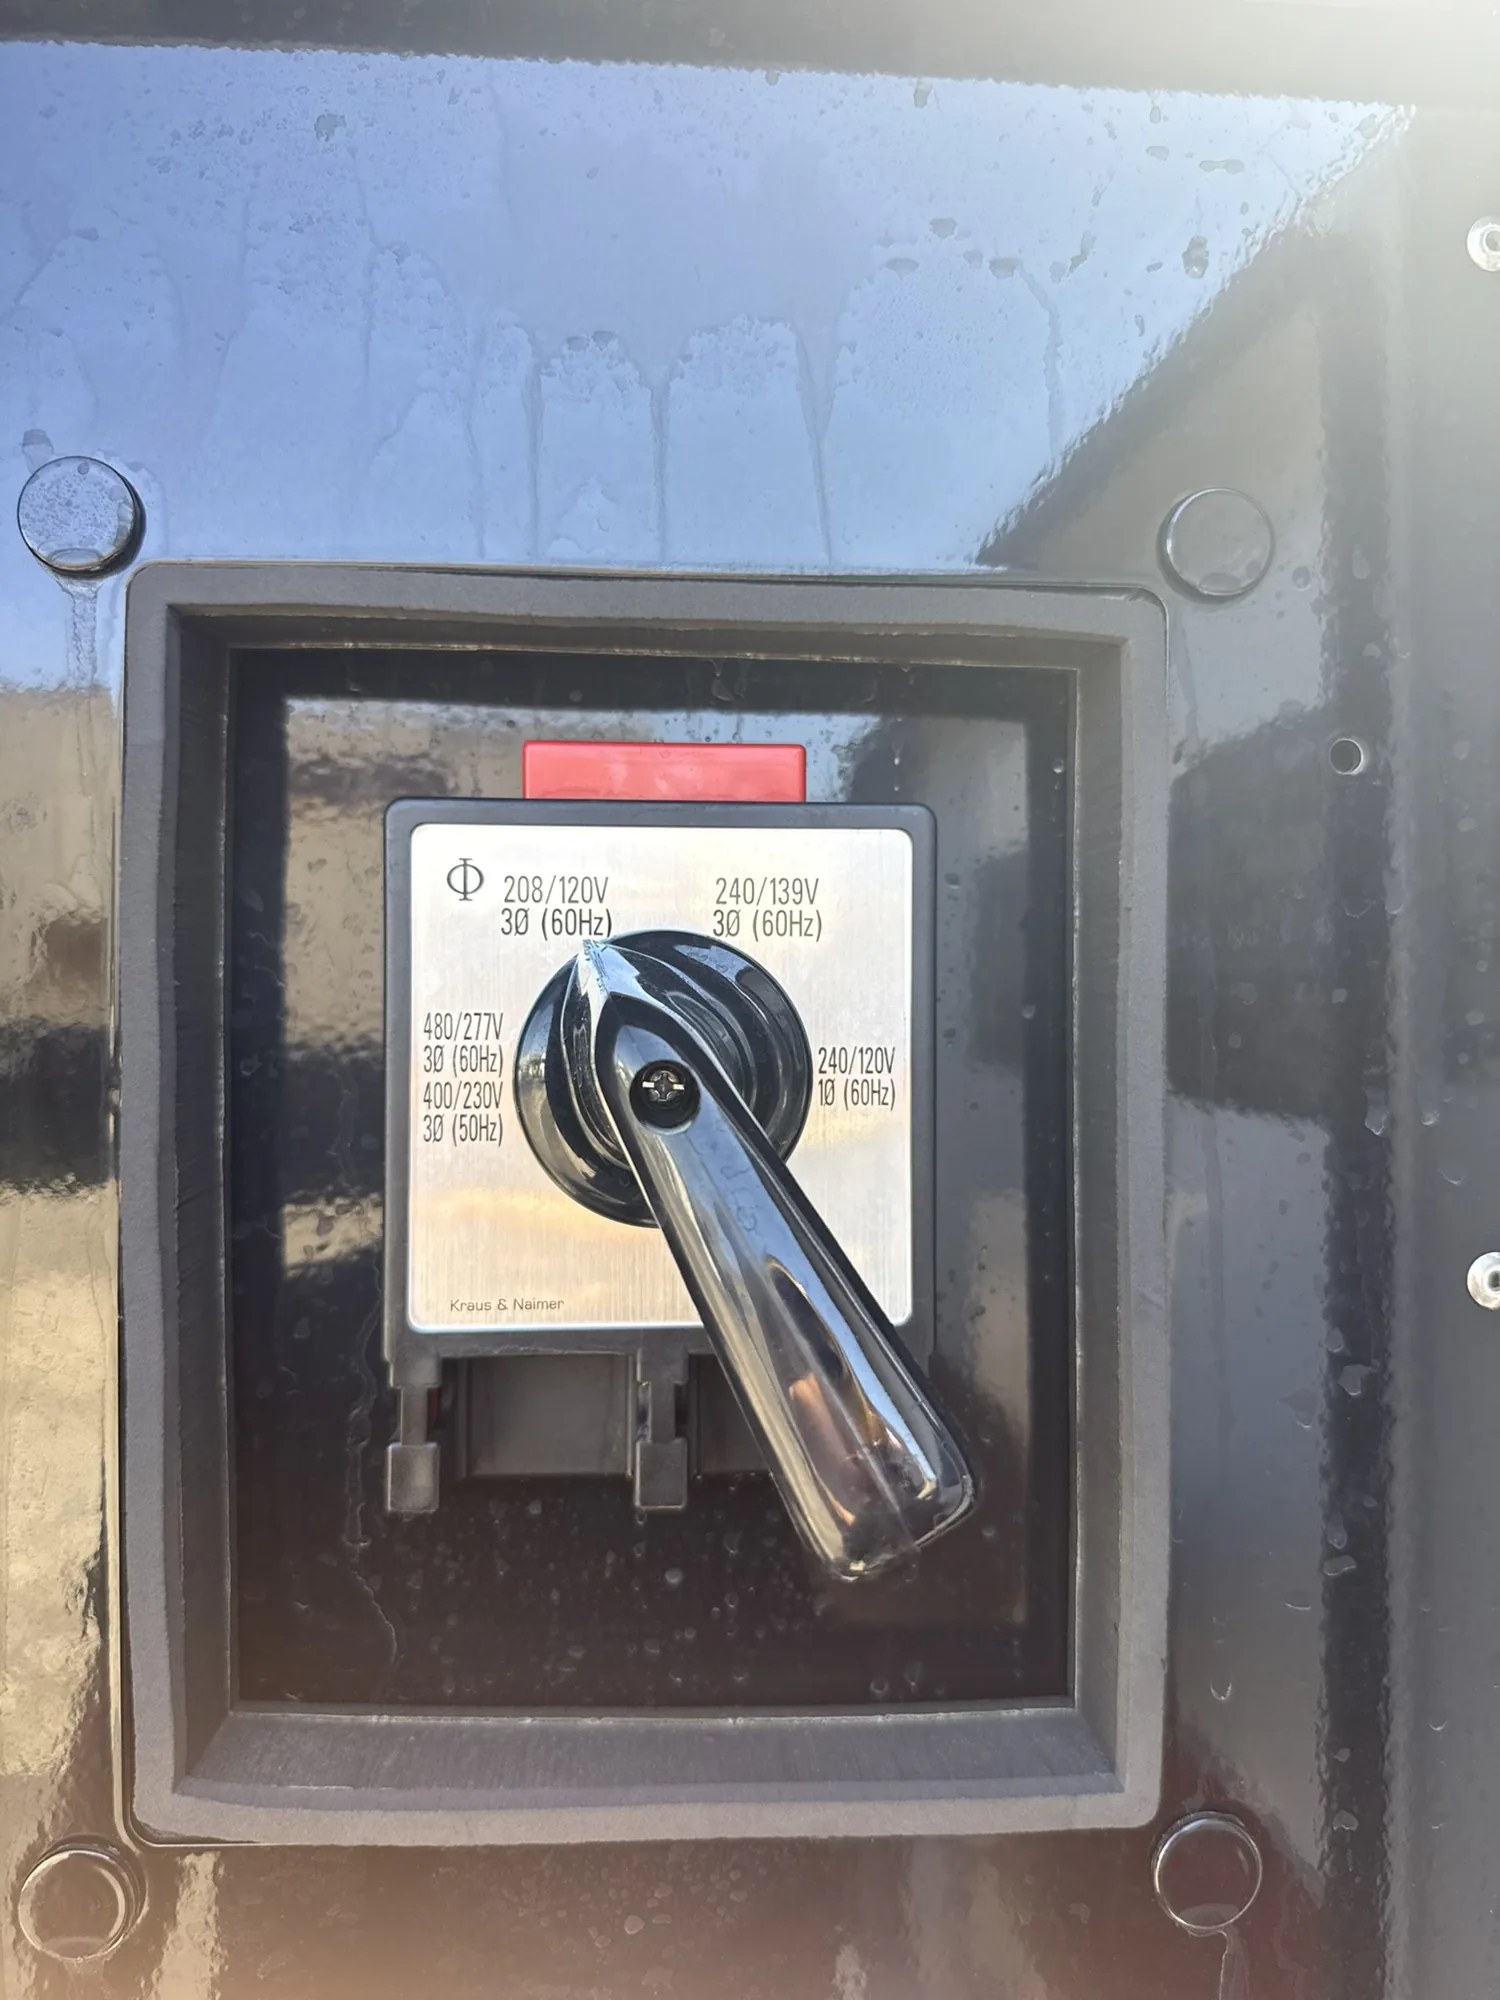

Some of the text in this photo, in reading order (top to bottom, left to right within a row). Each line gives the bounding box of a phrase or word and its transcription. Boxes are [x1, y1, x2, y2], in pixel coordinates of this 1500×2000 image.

[504, 875, 609, 904] 208/120V
[715, 877, 819, 906] 240/139V
[541, 908, 612, 941] (60Hz)
[753, 909, 822, 942] (60Hz)
[423, 1012, 504, 1041] 480/277V
[452, 1044, 503, 1078] (60Hz)
[818, 1046, 896, 1075] 240/120V
[423, 1080, 504, 1111] 400/230V
[843, 1078, 896, 1111] (60Hz)
[452, 1113, 503, 1147] (50Hz)
[450, 1297, 565, 1312] Kraus & Naimer
